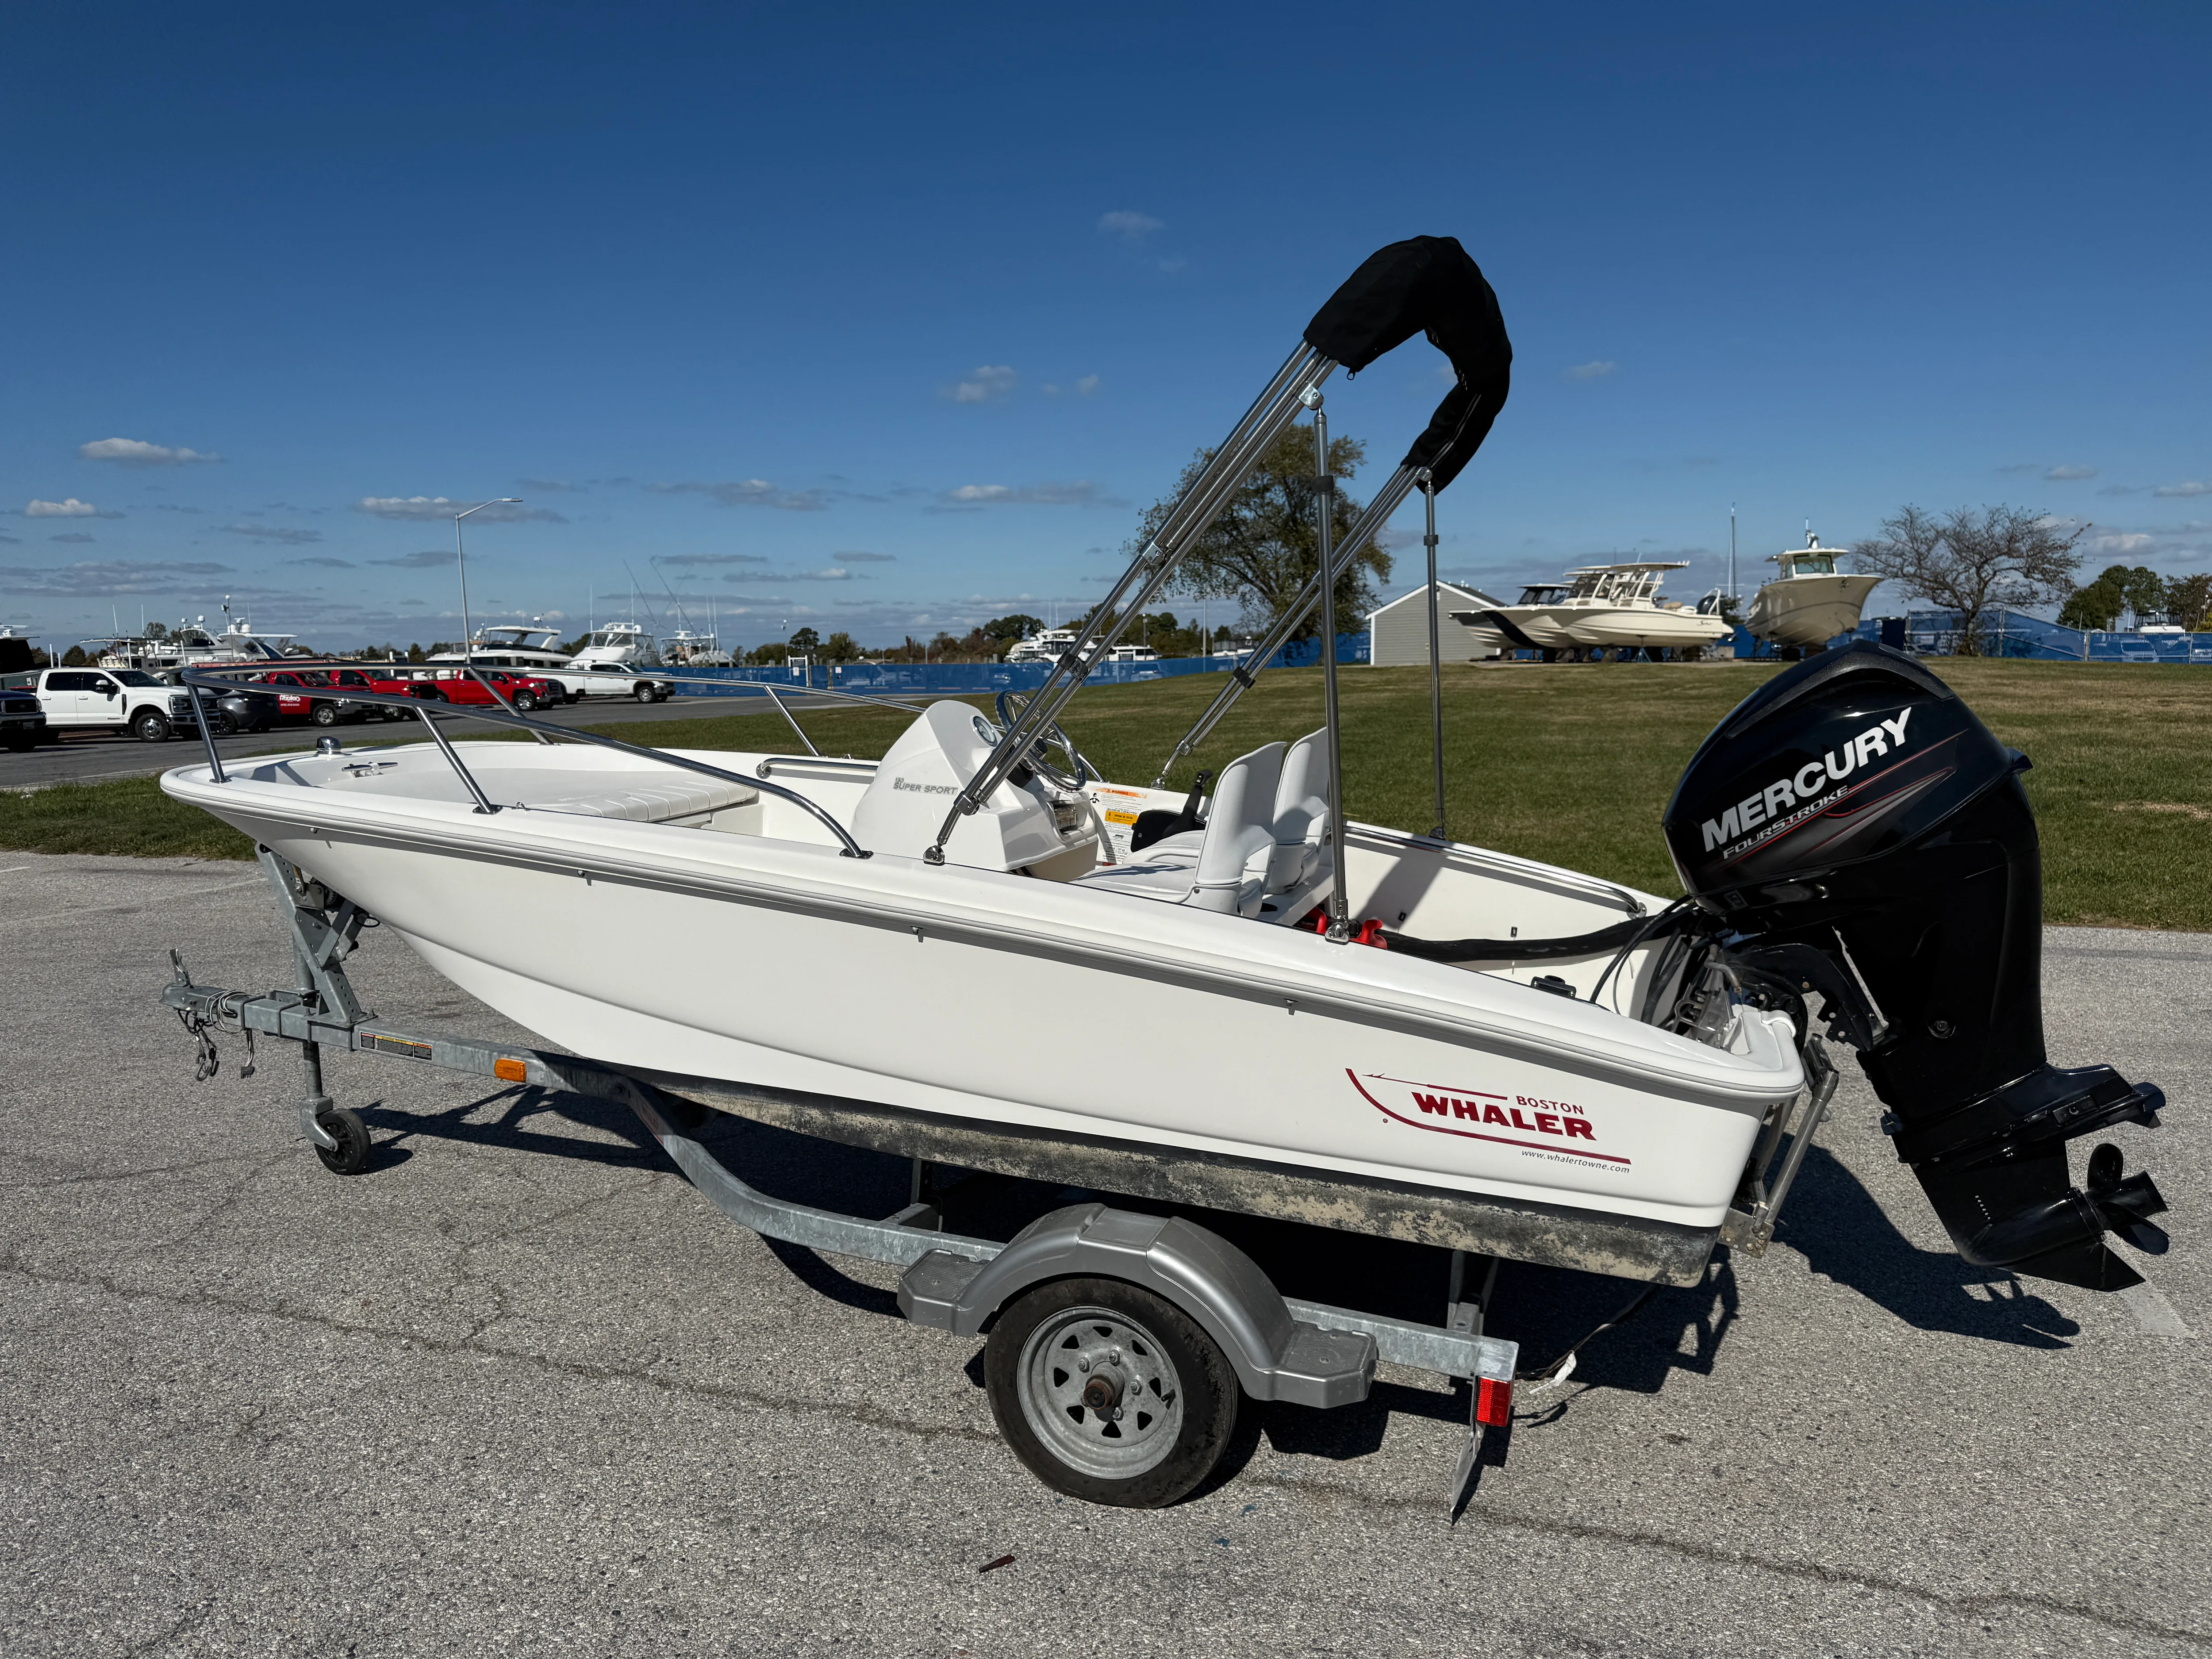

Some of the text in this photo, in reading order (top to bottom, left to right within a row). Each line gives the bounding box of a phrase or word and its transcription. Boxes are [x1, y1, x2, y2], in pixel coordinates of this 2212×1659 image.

[893, 782, 958, 794] SUPER SPORT
[1701, 707, 1912, 852] MERCURY
[1723, 785, 1849, 859] FOURSTROKE
[1411, 1091, 1597, 1141] WHALER
[1516, 1095, 1584, 1115] BOSTON
[1522, 1150, 1630, 1173] www.whalertowne.com
